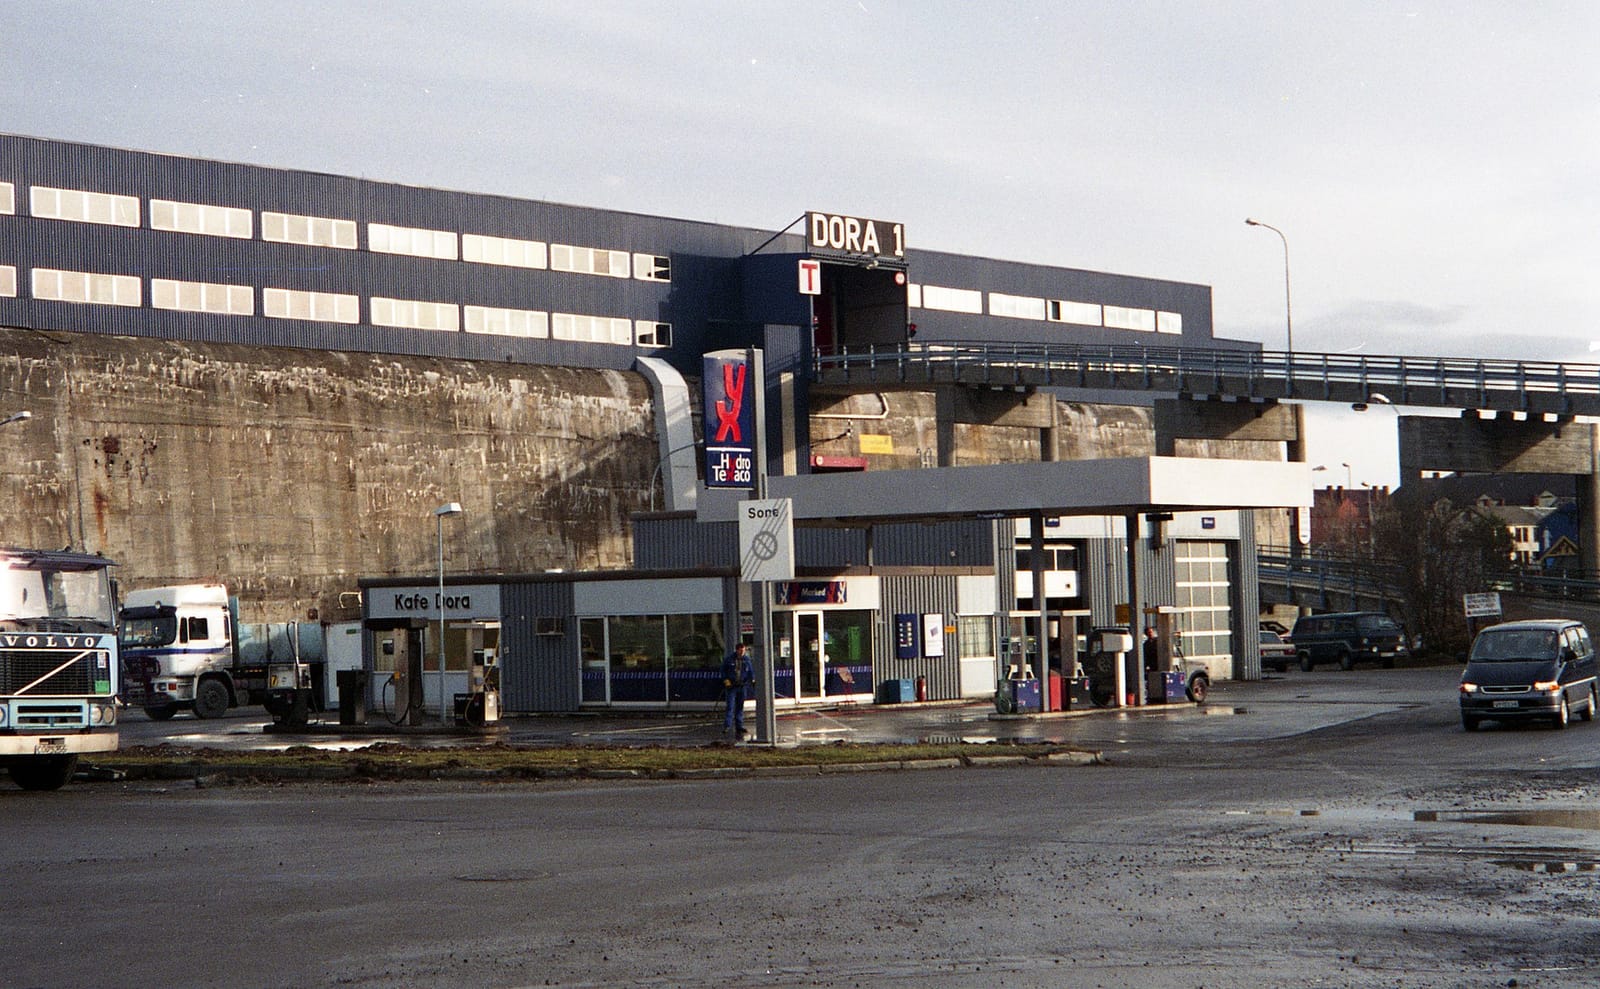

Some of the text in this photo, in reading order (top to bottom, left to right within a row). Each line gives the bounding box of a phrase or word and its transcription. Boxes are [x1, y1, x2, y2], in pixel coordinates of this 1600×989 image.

[812, 213, 904, 257] DORA 1
[801, 263, 818, 291] T
[747, 507, 780, 519] Sone
[394, 593, 470, 611] Kafe Dora
[4, 636, 94, 647] VOLVO
